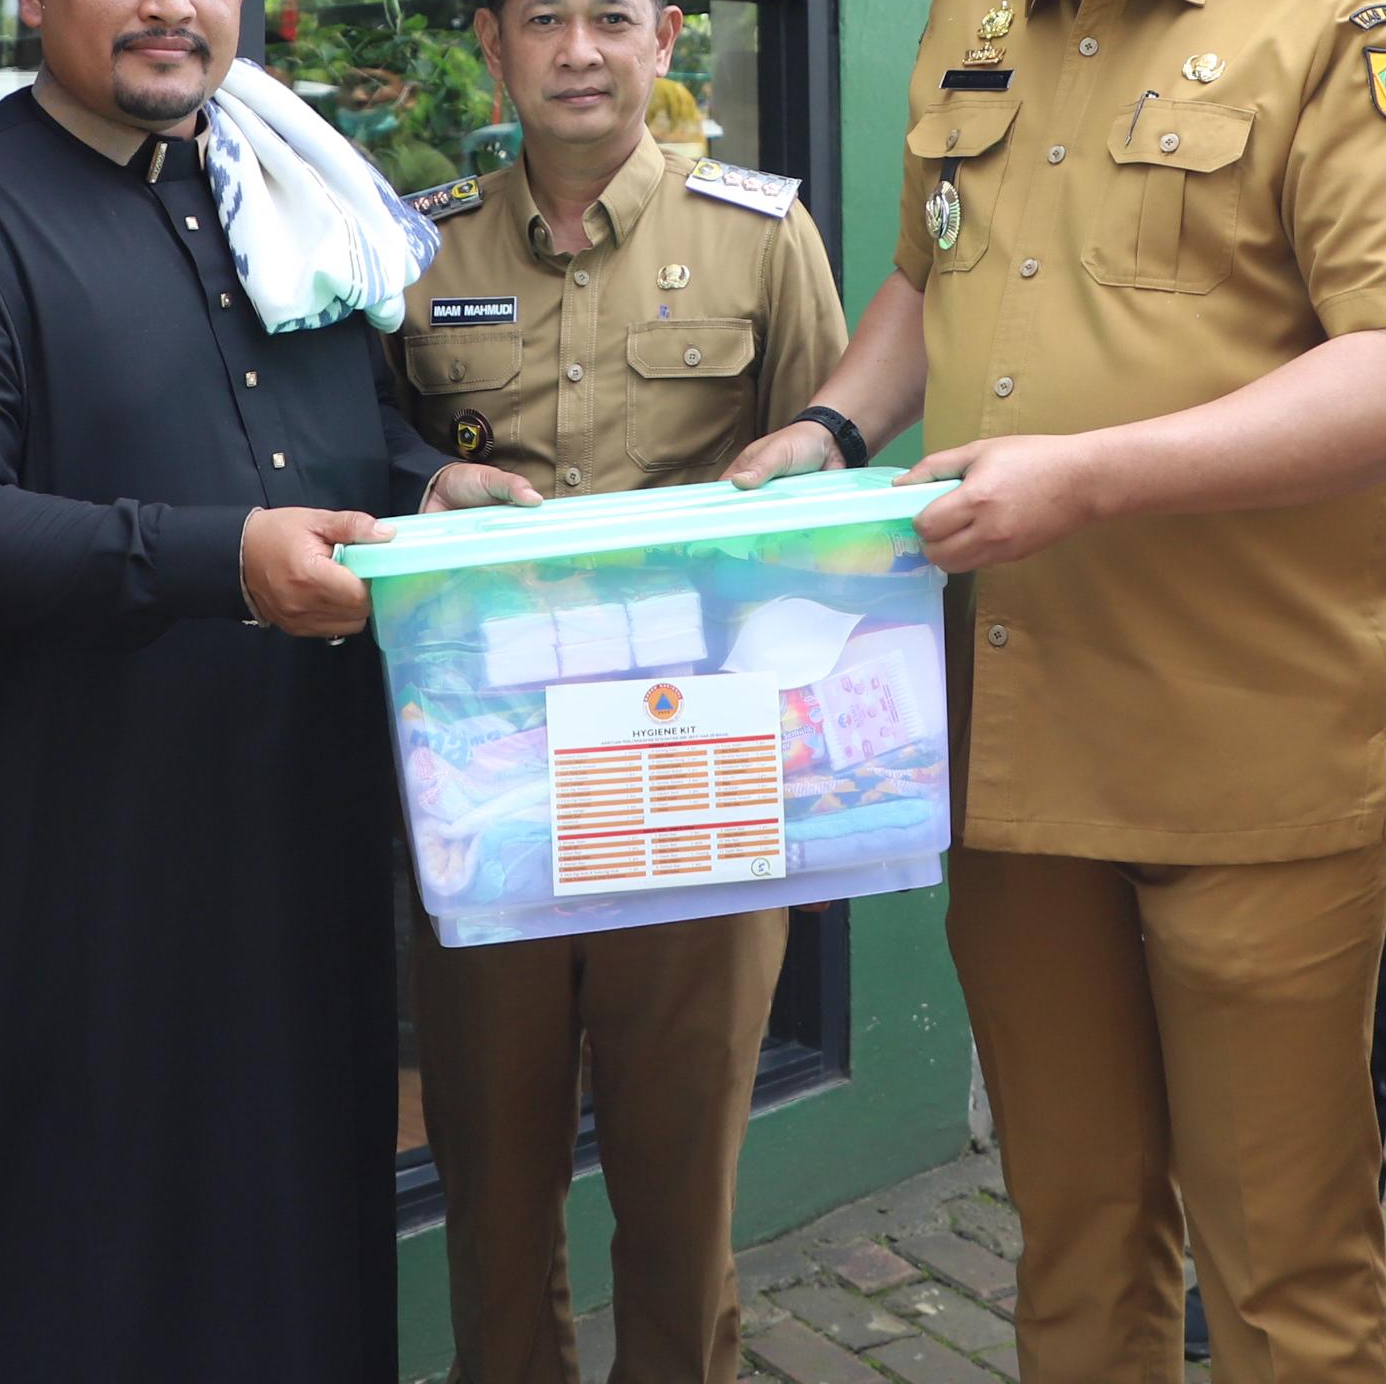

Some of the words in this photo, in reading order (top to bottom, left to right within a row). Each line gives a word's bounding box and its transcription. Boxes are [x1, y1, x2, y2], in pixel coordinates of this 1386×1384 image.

[433, 305, 461, 317] IMAM
[464, 303, 513, 317] MAHMUDI
[632, 727, 678, 738] HYGIENE
[680, 725, 696, 735] KIT
